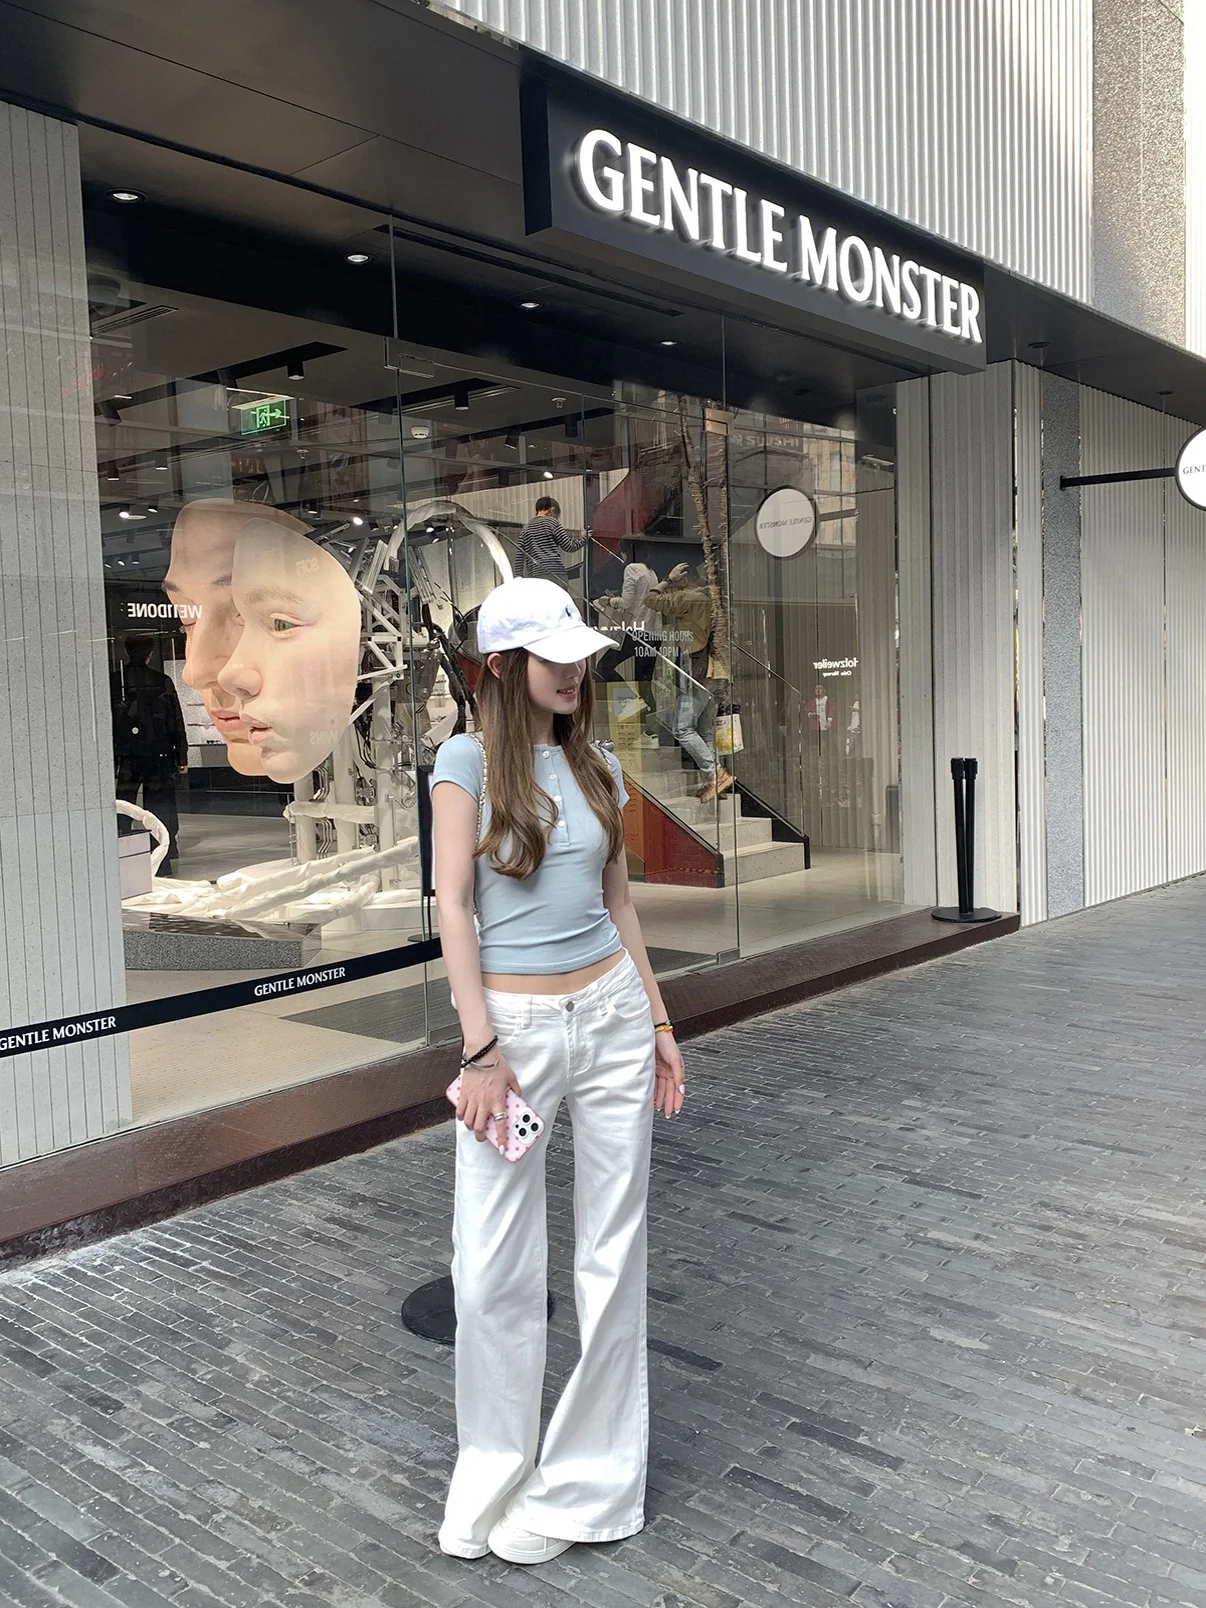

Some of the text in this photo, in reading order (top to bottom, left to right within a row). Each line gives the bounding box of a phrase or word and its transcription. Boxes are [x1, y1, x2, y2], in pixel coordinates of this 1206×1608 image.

[578, 128, 983, 344] GENTLE MONSTER
[632, 628, 694, 642] OPENING HOURS
[253, 966, 346, 997] GENTLE MONSTER
[0, 1015, 117, 1051] GENTLE MONSTER
